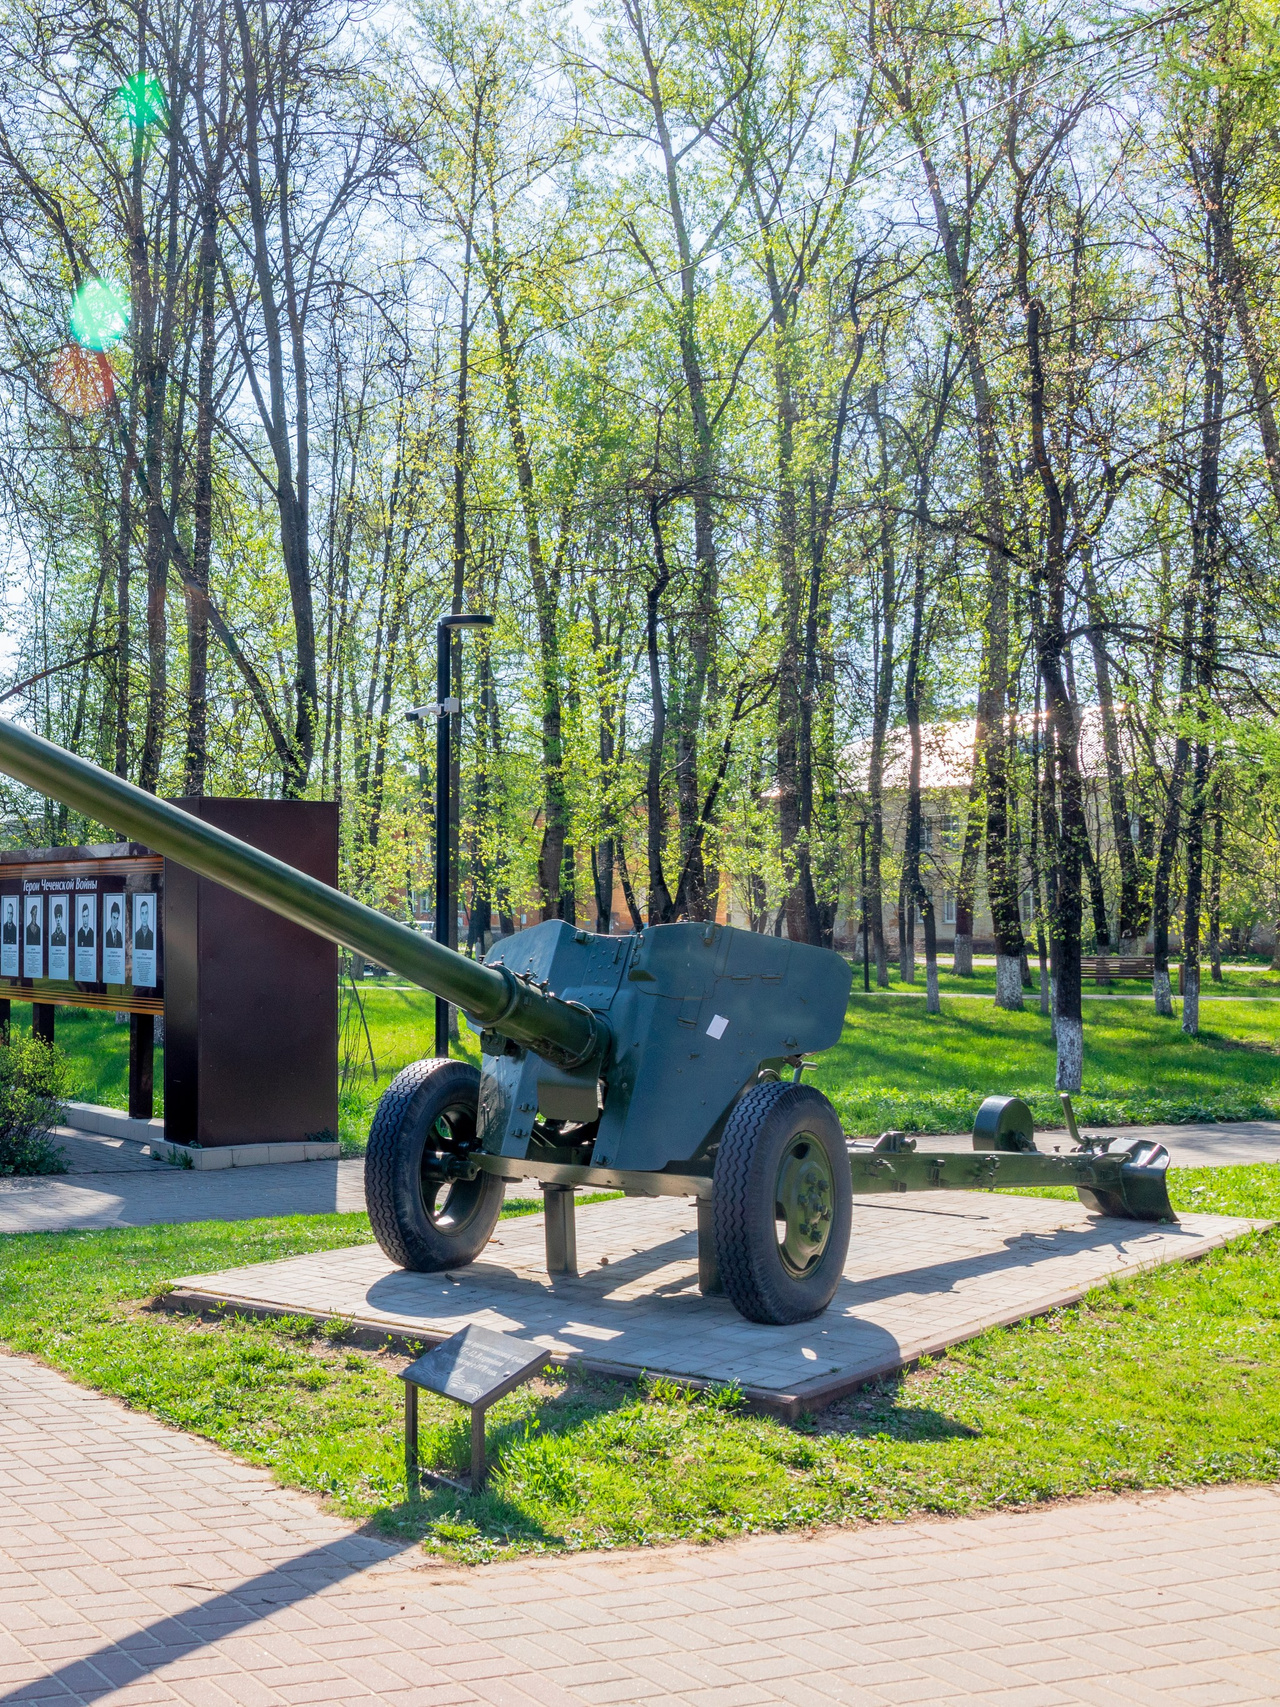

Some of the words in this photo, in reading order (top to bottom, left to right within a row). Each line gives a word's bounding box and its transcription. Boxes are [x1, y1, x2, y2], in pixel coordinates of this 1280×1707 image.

[23, 880, 40, 895] Герои
[41, 879, 74, 890] Чеченской
[75, 877, 98, 889] Войны
